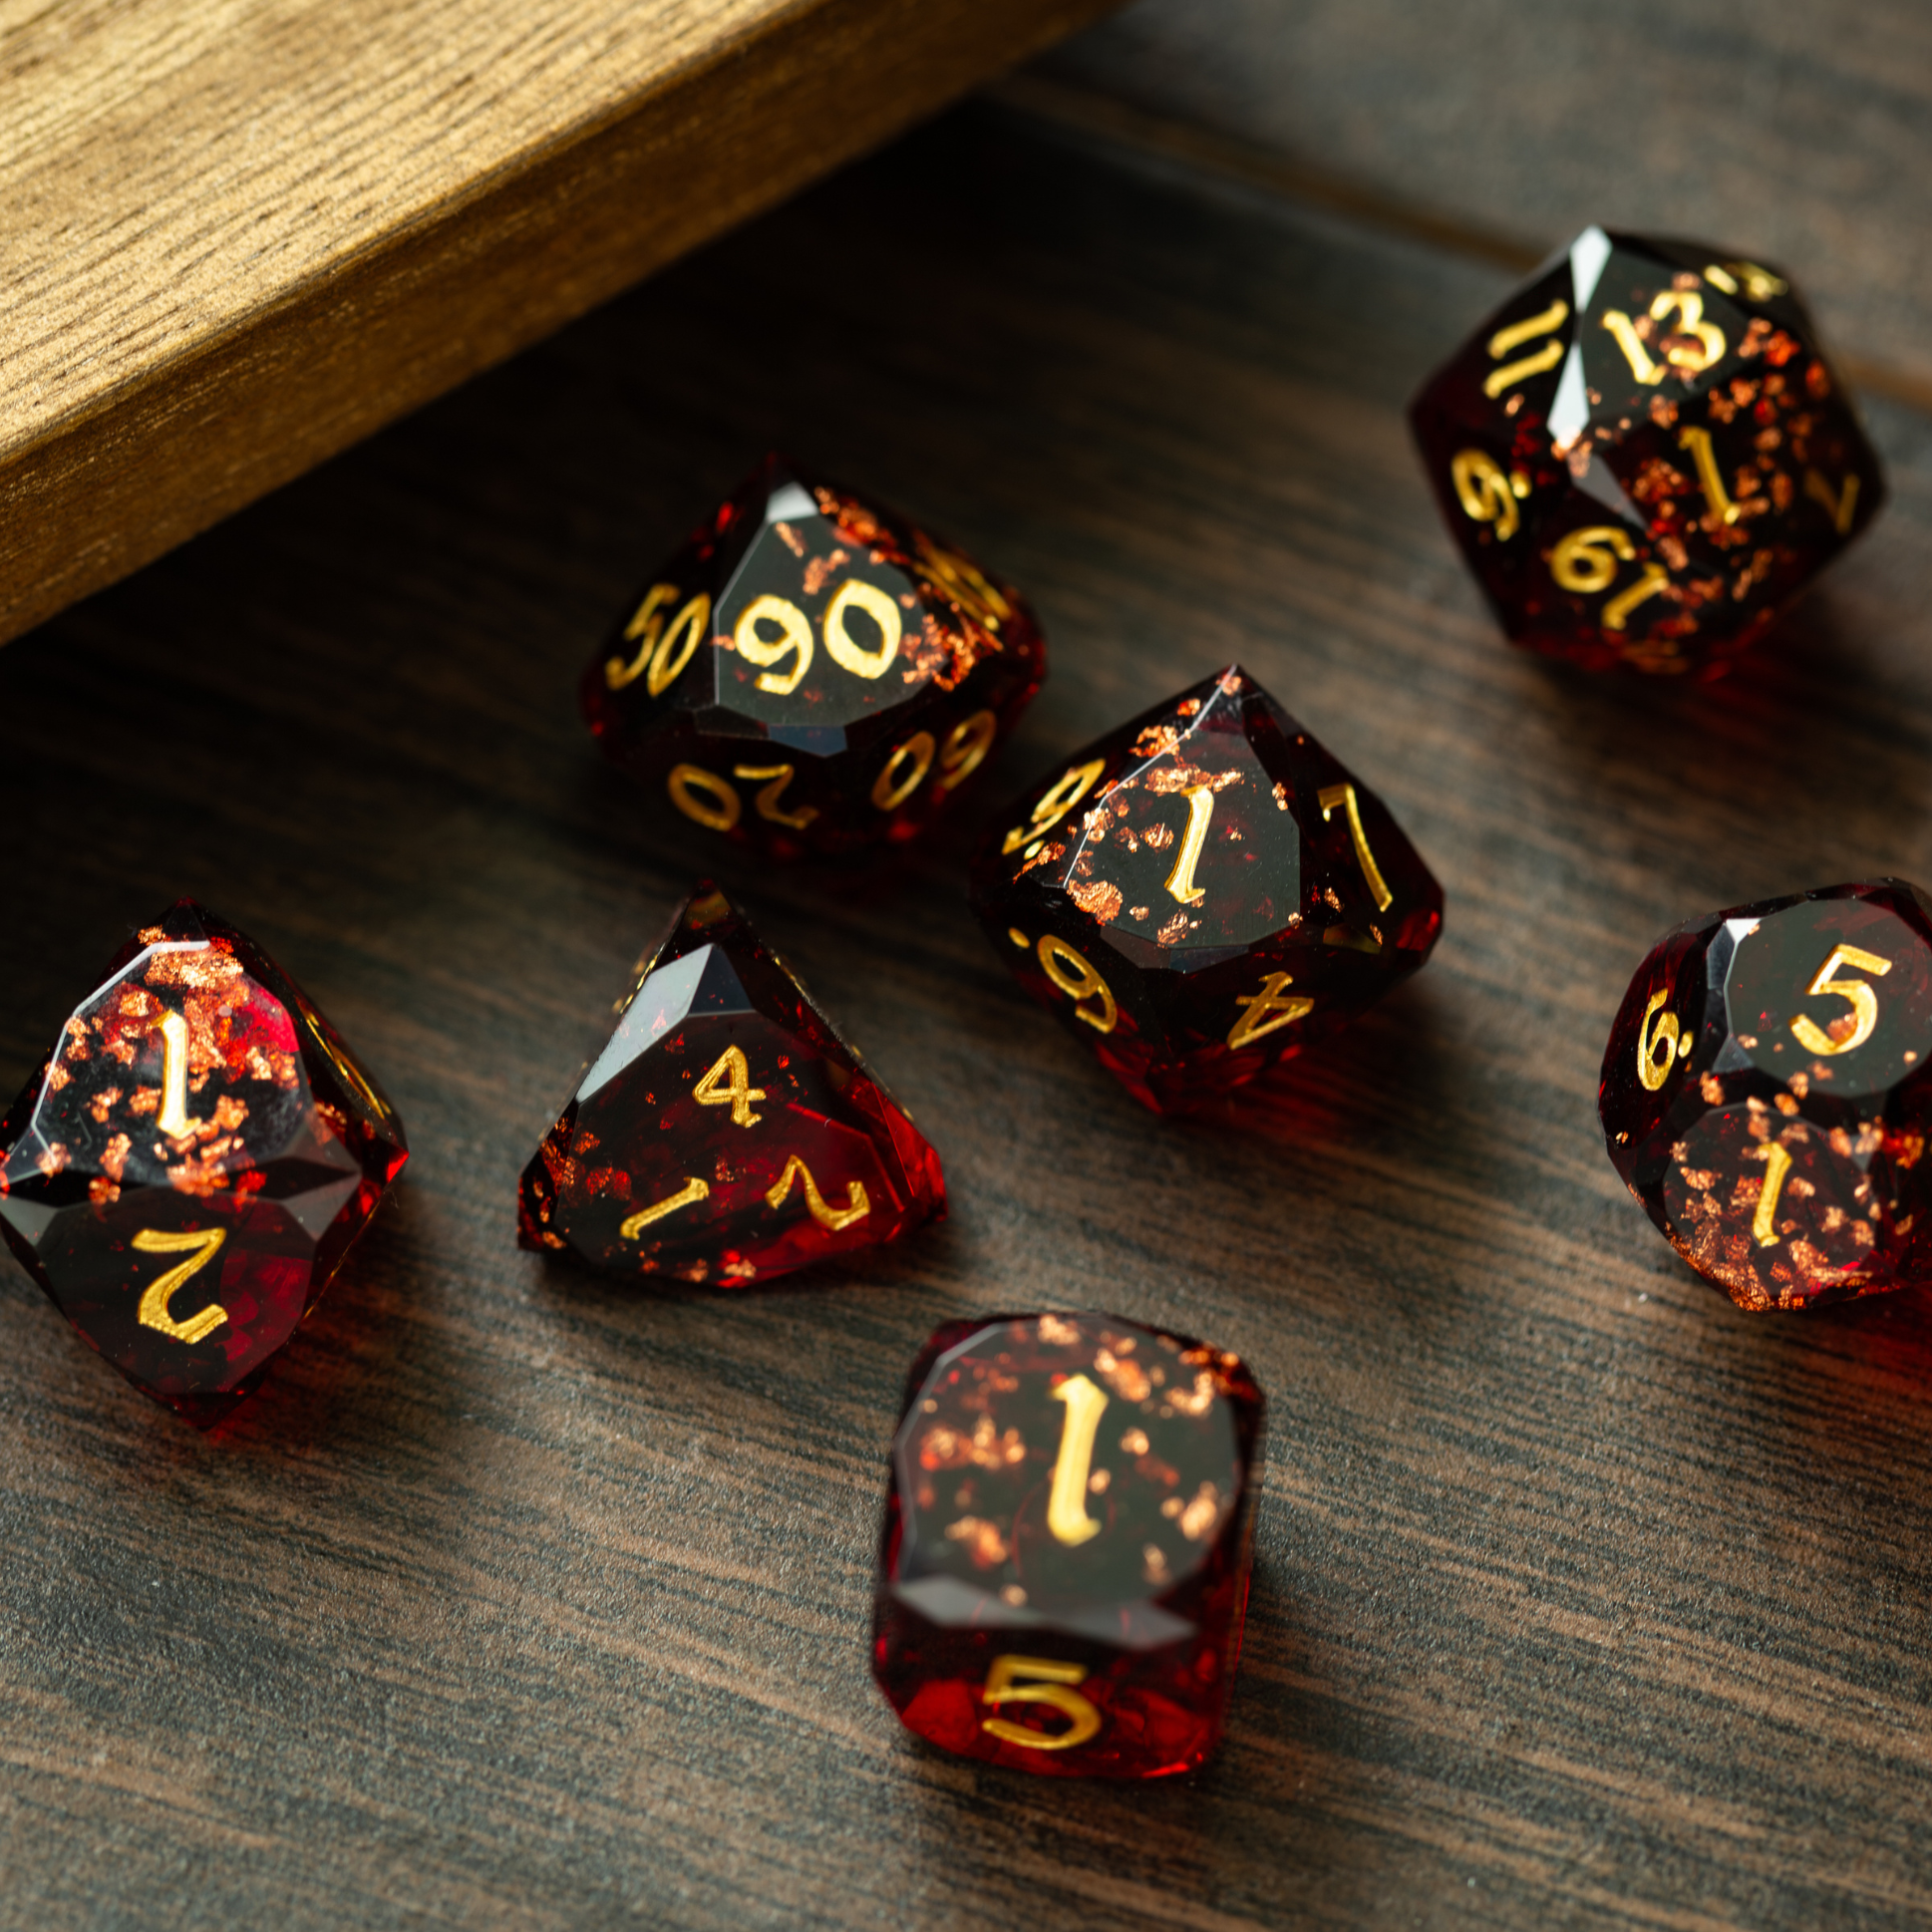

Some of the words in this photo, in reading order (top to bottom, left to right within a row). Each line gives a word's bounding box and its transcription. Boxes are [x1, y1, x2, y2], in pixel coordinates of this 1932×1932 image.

[1483, 299, 1568, 399] 11
[1603, 290, 1726, 385] 13
[1678, 426, 1741, 524] 1
[605, 583, 711, 696] 50
[734, 578, 901, 695] 90
[1163, 785, 1214, 903] 1
[1317, 783, 1393, 912] 7
[1226, 971, 1314, 1051] 4
[1788, 943, 1892, 1056] 5
[152, 1009, 202, 1139] 1
[692, 1045, 767, 1128] 4
[620, 1176, 709, 1240] 1
[766, 1154, 870, 1230] 2
[1753, 1140, 1792, 1248] 1
[131, 1227, 228, 1344] 2
[1047, 1374, 1110, 1547] 1
[982, 1654, 1102, 1750] 5
